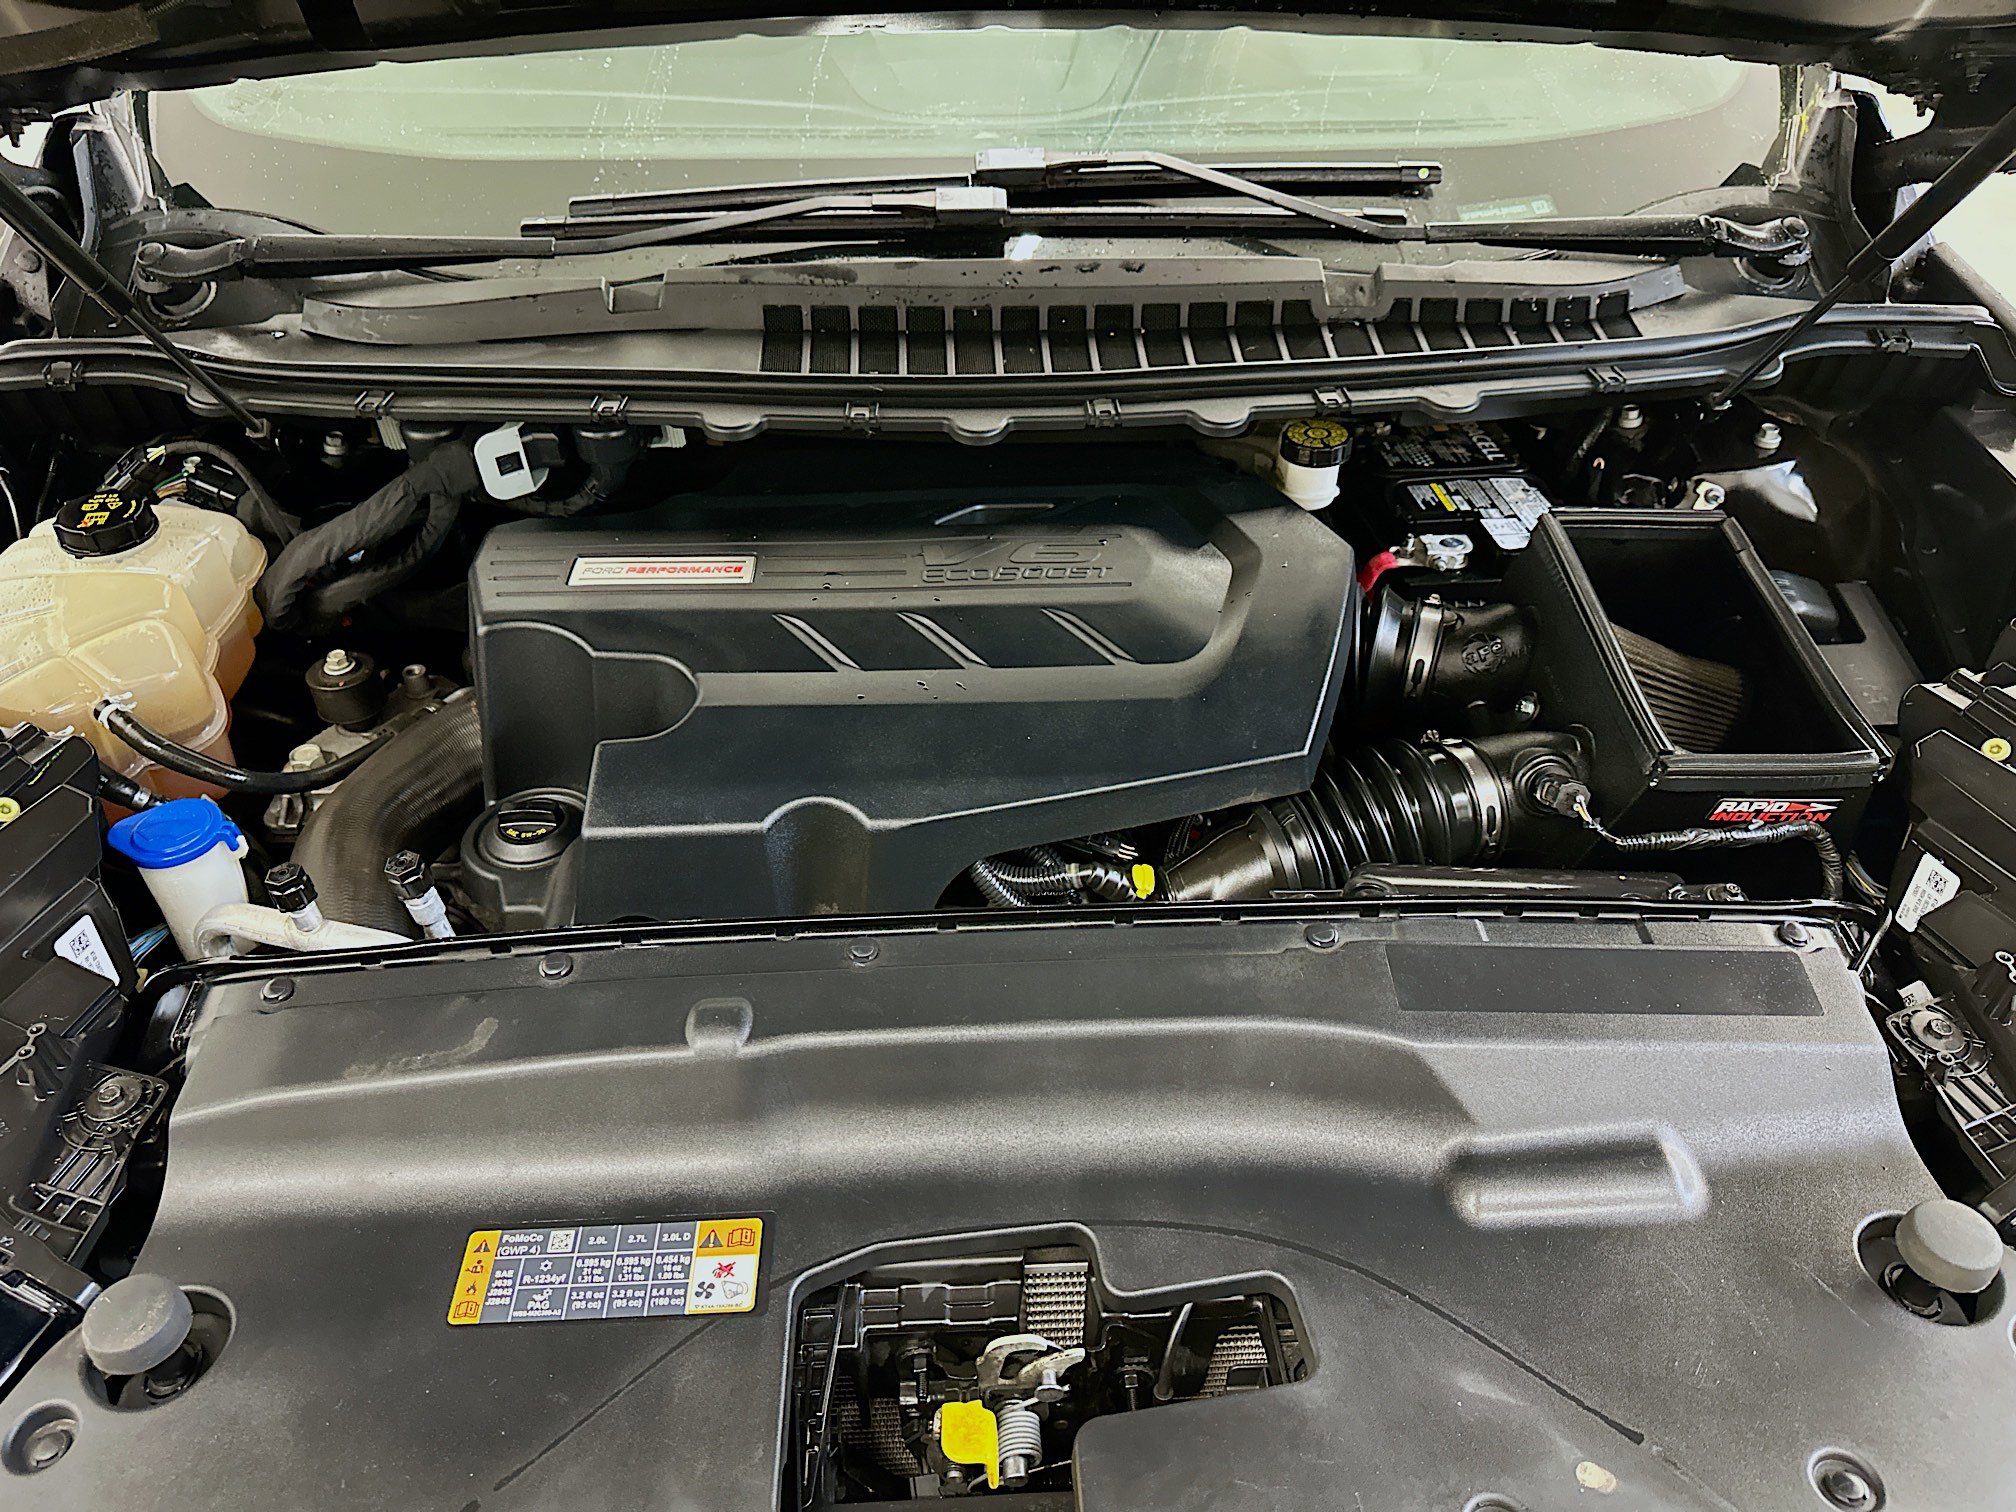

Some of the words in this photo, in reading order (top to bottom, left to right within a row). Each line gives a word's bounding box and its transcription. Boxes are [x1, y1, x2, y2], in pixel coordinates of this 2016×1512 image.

[582, 566, 624, 575] FORD
[626, 566, 744, 574] PERFORMANCE
[1714, 801, 1790, 813] RAPID
[1709, 812, 1832, 822] INDUCTION
[502, 1233, 544, 1243] FoMoCo
[588, 1236, 608, 1245] 2.0L
[627, 1234, 647, 1243] 2.7L
[662, 1233, 682, 1242] 2.0L
[683, 1232, 692, 1241] D
[497, 1246, 528, 1257] (GWP
[529, 1245, 541, 1255] 4)
[599, 1258, 611, 1268] kg
[640, 1256, 651, 1267] kg
[680, 1255, 691, 1265] kg
[495, 1270, 514, 1278] SAE
[522, 1274, 567, 1285] R-1234yf
[571, 1291, 584, 1300] 3.2
[593, 1291, 605, 1299] oz
[611, 1289, 625, 1298] 3.2
[527, 1300, 550, 1310] PAG
[587, 1300, 601, 1309] cc)
[628, 1298, 642, 1308] cc)
[670, 1297, 684, 1306] cc)
